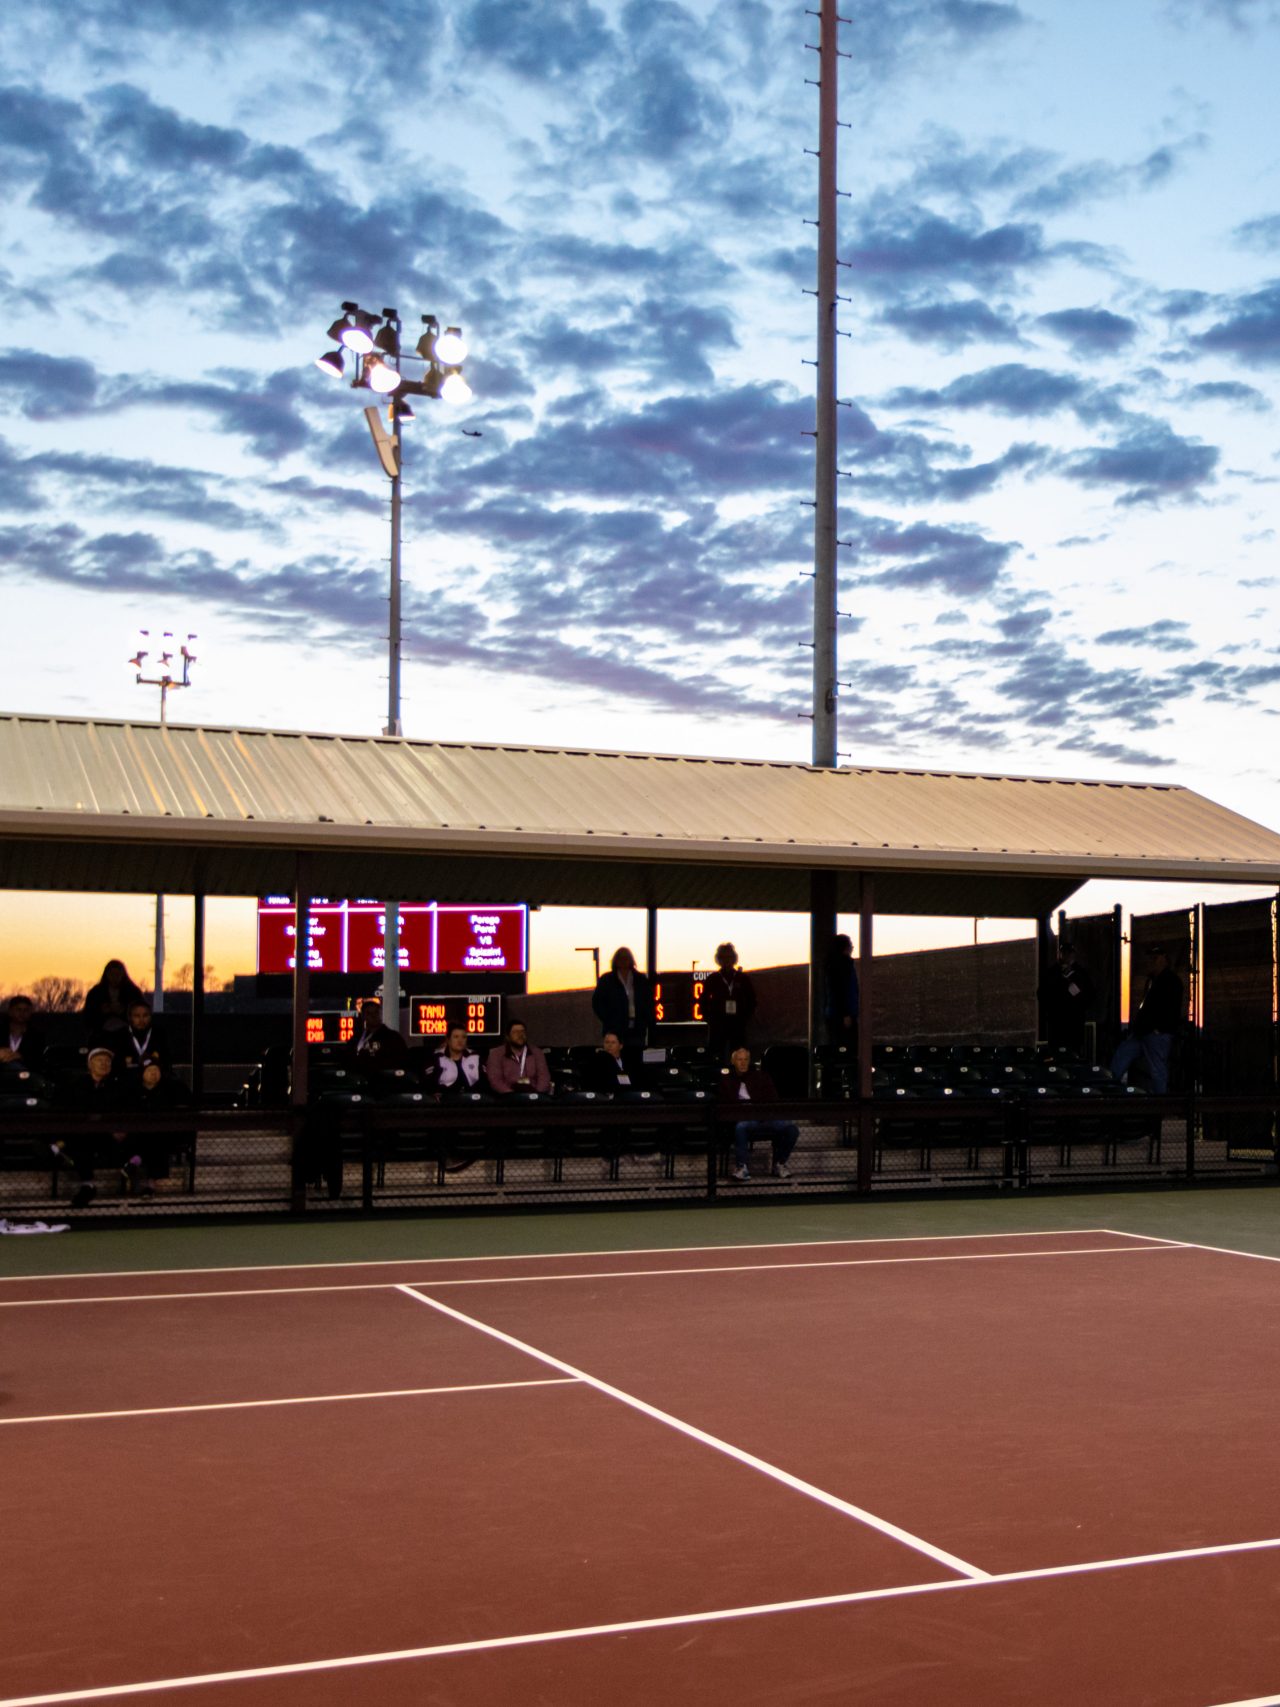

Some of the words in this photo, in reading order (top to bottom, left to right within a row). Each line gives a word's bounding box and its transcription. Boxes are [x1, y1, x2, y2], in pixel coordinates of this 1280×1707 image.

[419, 1005, 446, 1019] TAMU
[307, 1018, 323, 1030] AMU
[419, 1020, 447, 1034] TEXAS
